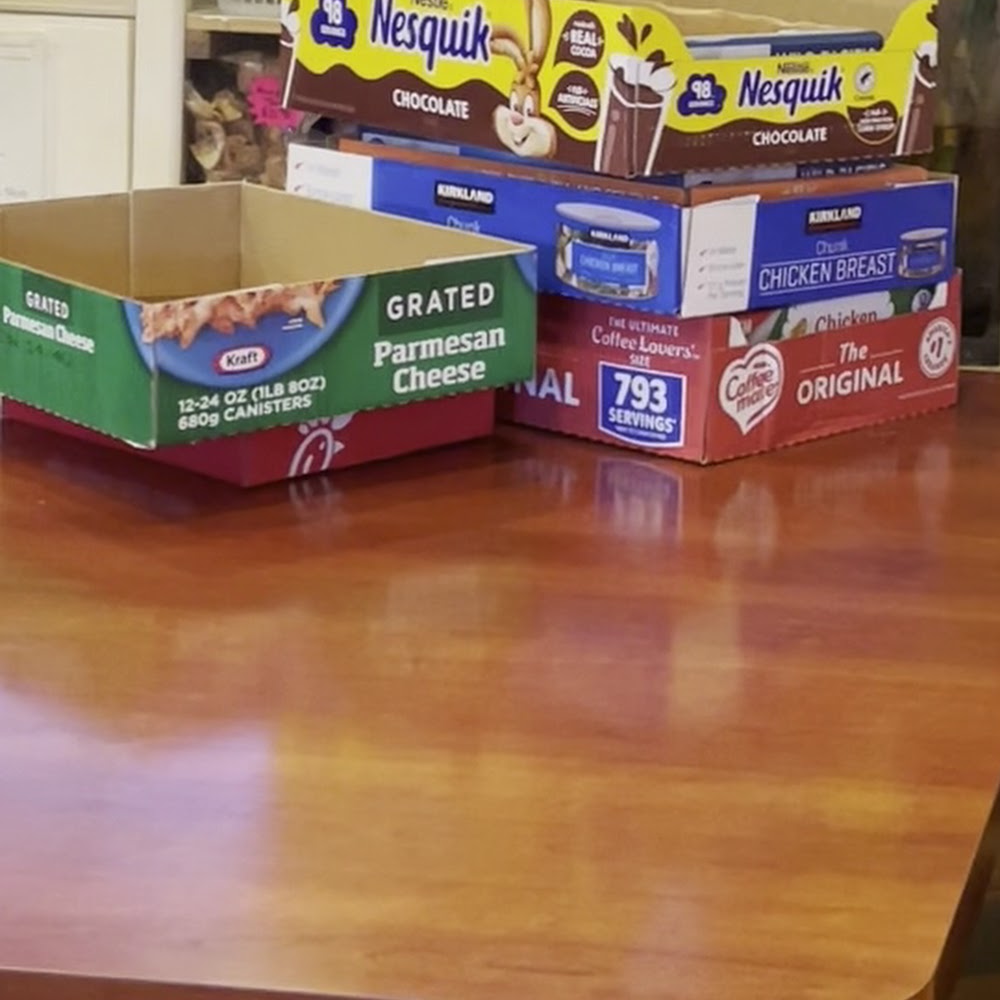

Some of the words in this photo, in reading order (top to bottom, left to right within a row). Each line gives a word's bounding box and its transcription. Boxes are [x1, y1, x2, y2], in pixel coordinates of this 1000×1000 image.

[570, 29, 598, 47] REAL
[393, 89, 470, 119] CHOCOLATE
[690, 80, 712, 99] 98
[739, 66, 843, 116] Nesquik
[753, 127, 828, 146] CHOCOLATE
[437, 184, 494, 204] KIRKLAND
[808, 206, 862, 224] KIRKLAND
[759, 263, 834, 291] CHICKEN
[836, 252, 897, 280] BREAST
[26, 291, 69, 319] GRATED
[387, 282, 496, 320] GRATED
[609, 316, 626, 329] THE
[628, 320, 679, 337] ULTIMATE
[815, 309, 878, 331] Chicken
[56, 325, 95, 354] Cheese
[374, 327, 506, 368] Parmesan
[591, 325, 638, 351] Coffee
[840, 341, 869, 364] The
[226, 351, 259, 367] Kraft
[629, 354, 651, 368] SIZE
[393, 360, 486, 394] Cheese
[725, 366, 775, 401] Coffee
[797, 360, 904, 405] ORIGINAL
[178, 392, 221, 414] 12-24
[224, 389, 248, 405] OZ
[252, 384, 283, 405] (1LB
[614, 372, 668, 413] 793
[736, 382, 777, 413] mate
[178, 410, 220, 430] 680g
[223, 394, 312, 422] CANISTERS
